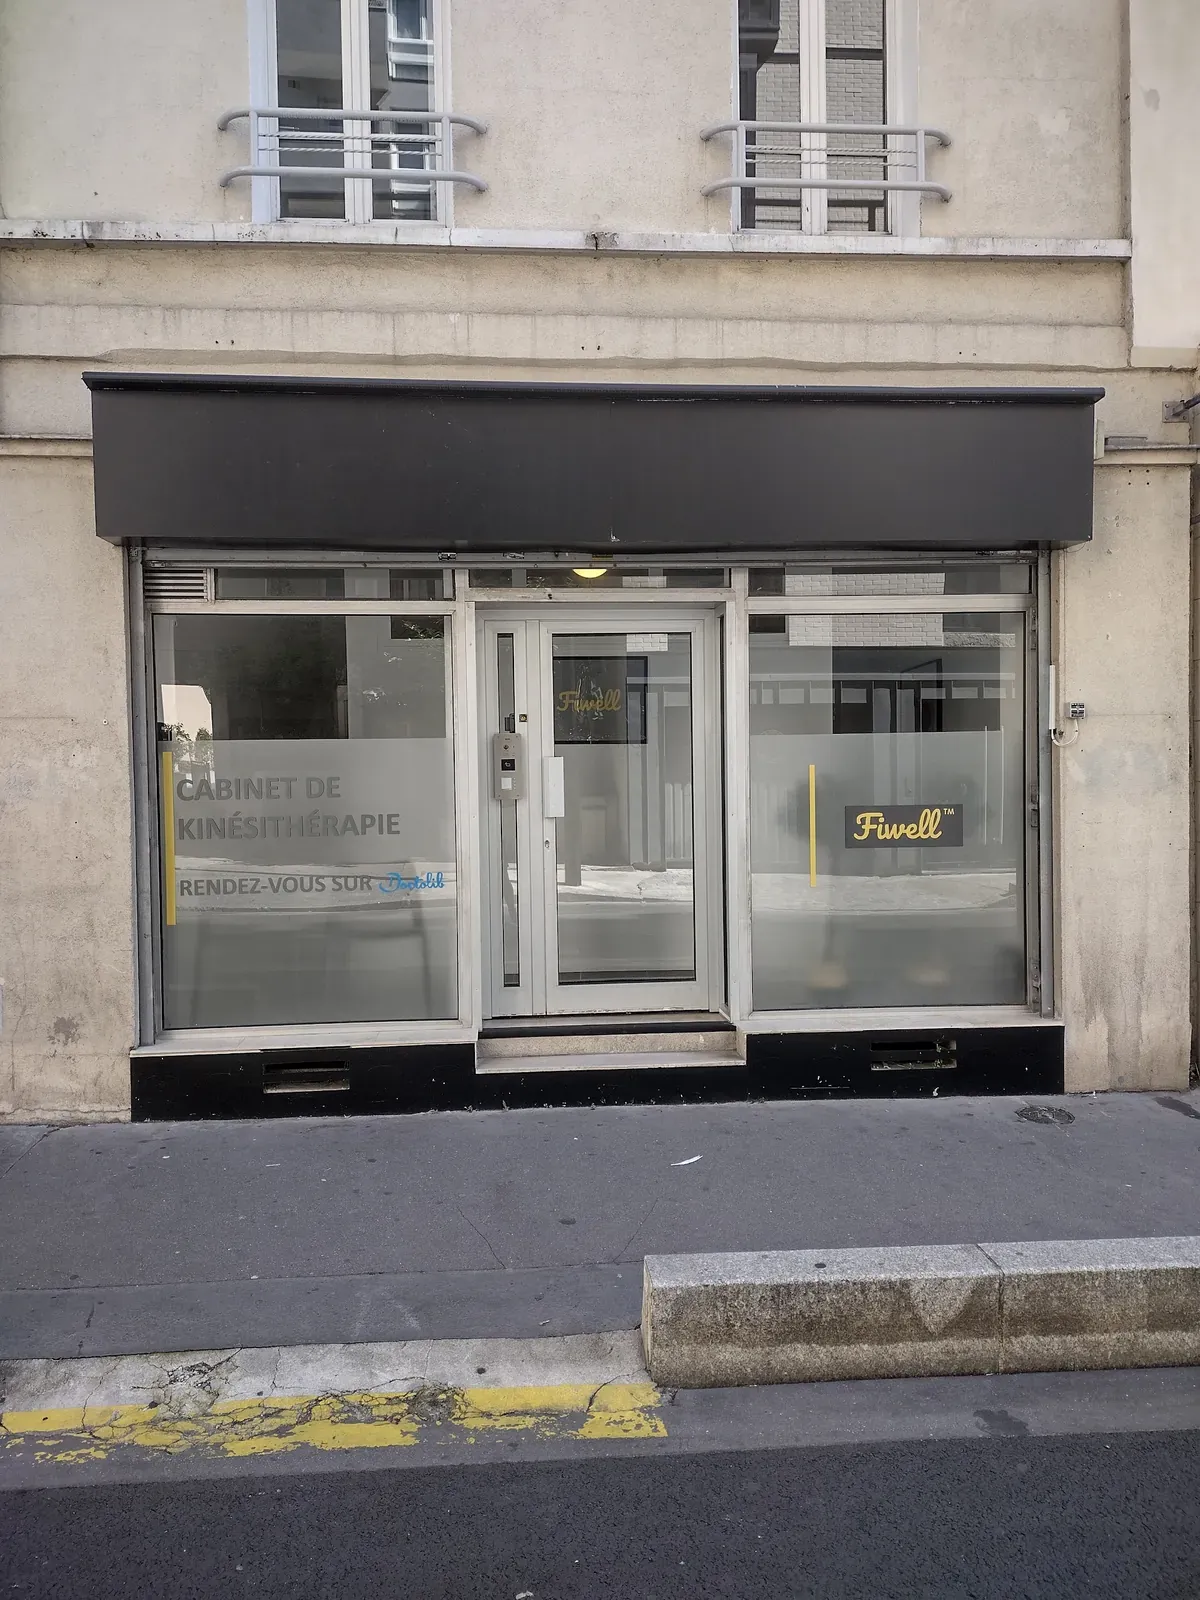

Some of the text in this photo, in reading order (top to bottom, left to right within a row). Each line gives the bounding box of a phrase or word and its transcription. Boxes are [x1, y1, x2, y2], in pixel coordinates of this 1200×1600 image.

[177, 776, 342, 801] CABINET DE
[178, 809, 401, 840] KINÉSITHÉRAPIE
[180, 876, 326, 897] RENDEZ-VOUS
[331, 875, 373, 892] SUR
